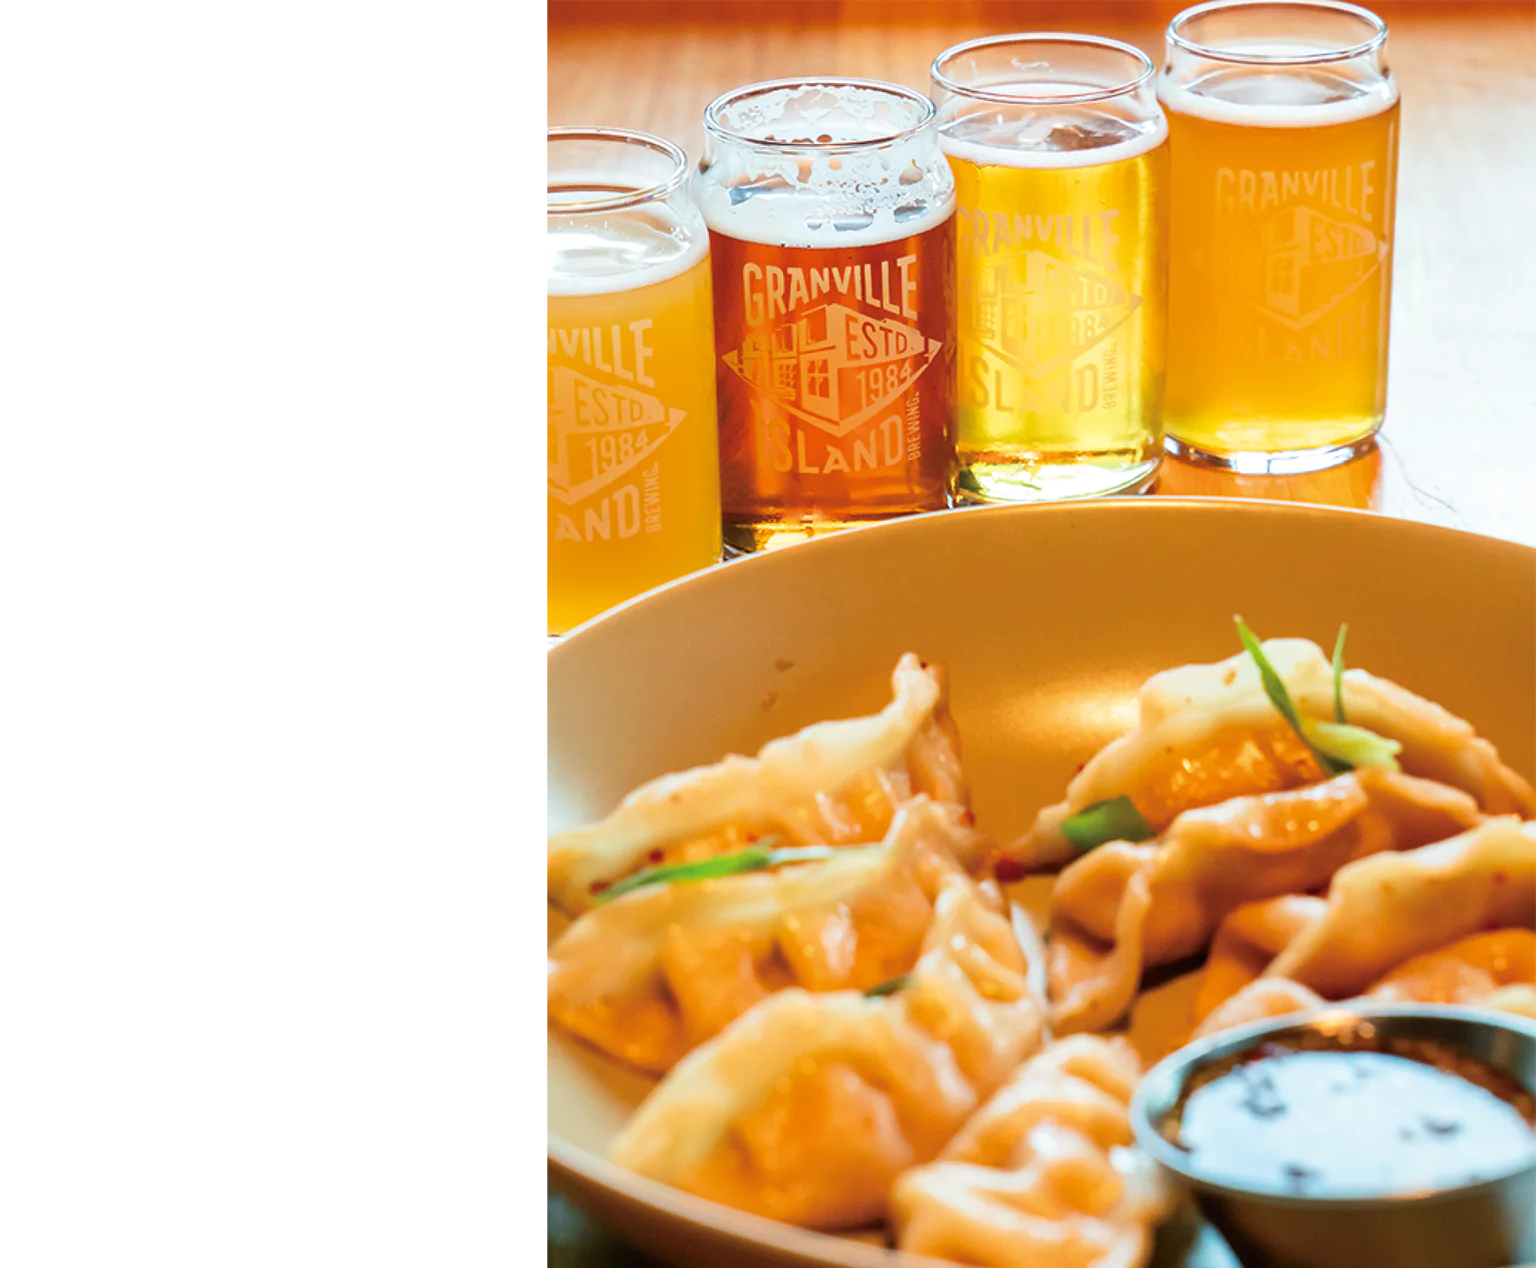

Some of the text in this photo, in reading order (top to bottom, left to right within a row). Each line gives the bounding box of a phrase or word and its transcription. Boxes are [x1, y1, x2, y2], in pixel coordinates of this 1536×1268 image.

[1215, 160, 1375, 223] GRANVILLE
[743, 254, 919, 327] GRANVILLE
[855, 362, 912, 412] 1984
[585, 429, 650, 478] 1984
